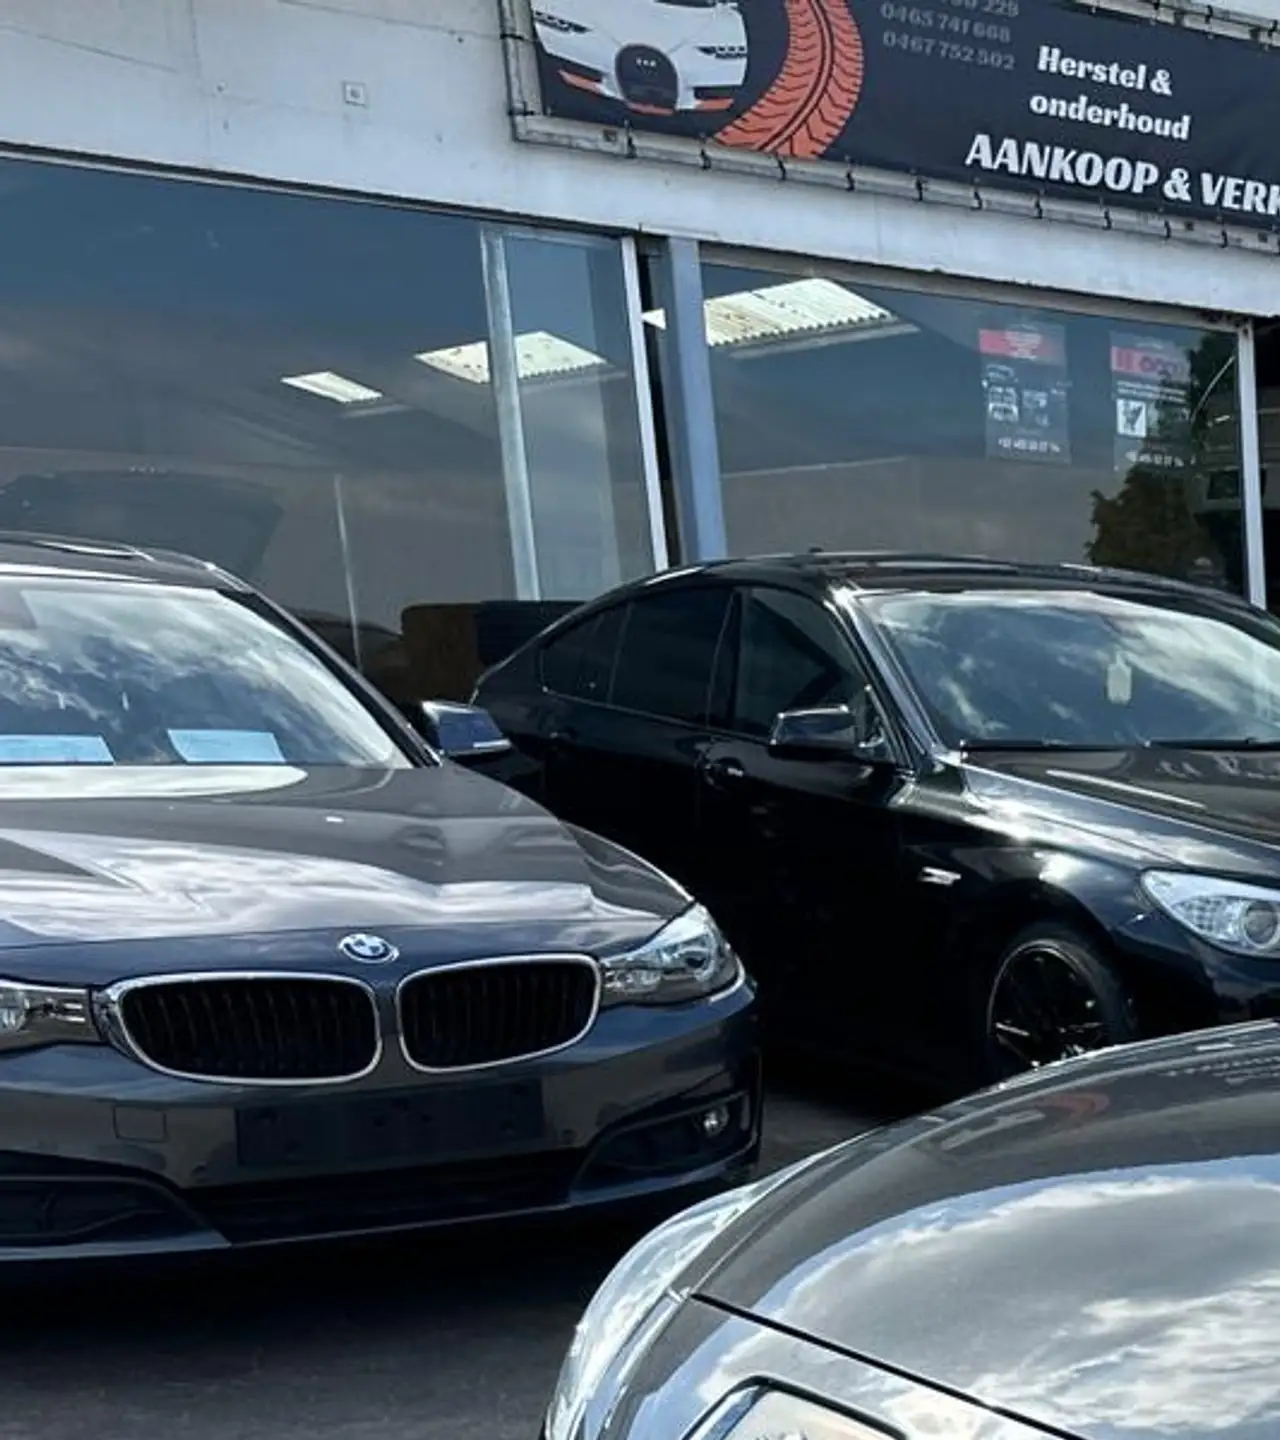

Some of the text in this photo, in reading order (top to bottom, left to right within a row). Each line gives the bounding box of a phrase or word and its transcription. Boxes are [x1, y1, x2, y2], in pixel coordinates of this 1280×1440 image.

[1037, 45, 1173, 97] Herstel &
[1029, 94, 1191, 141] onderhoud
[965, 133, 1160, 194] AANKOOP
[1162, 167, 1192, 202] &
